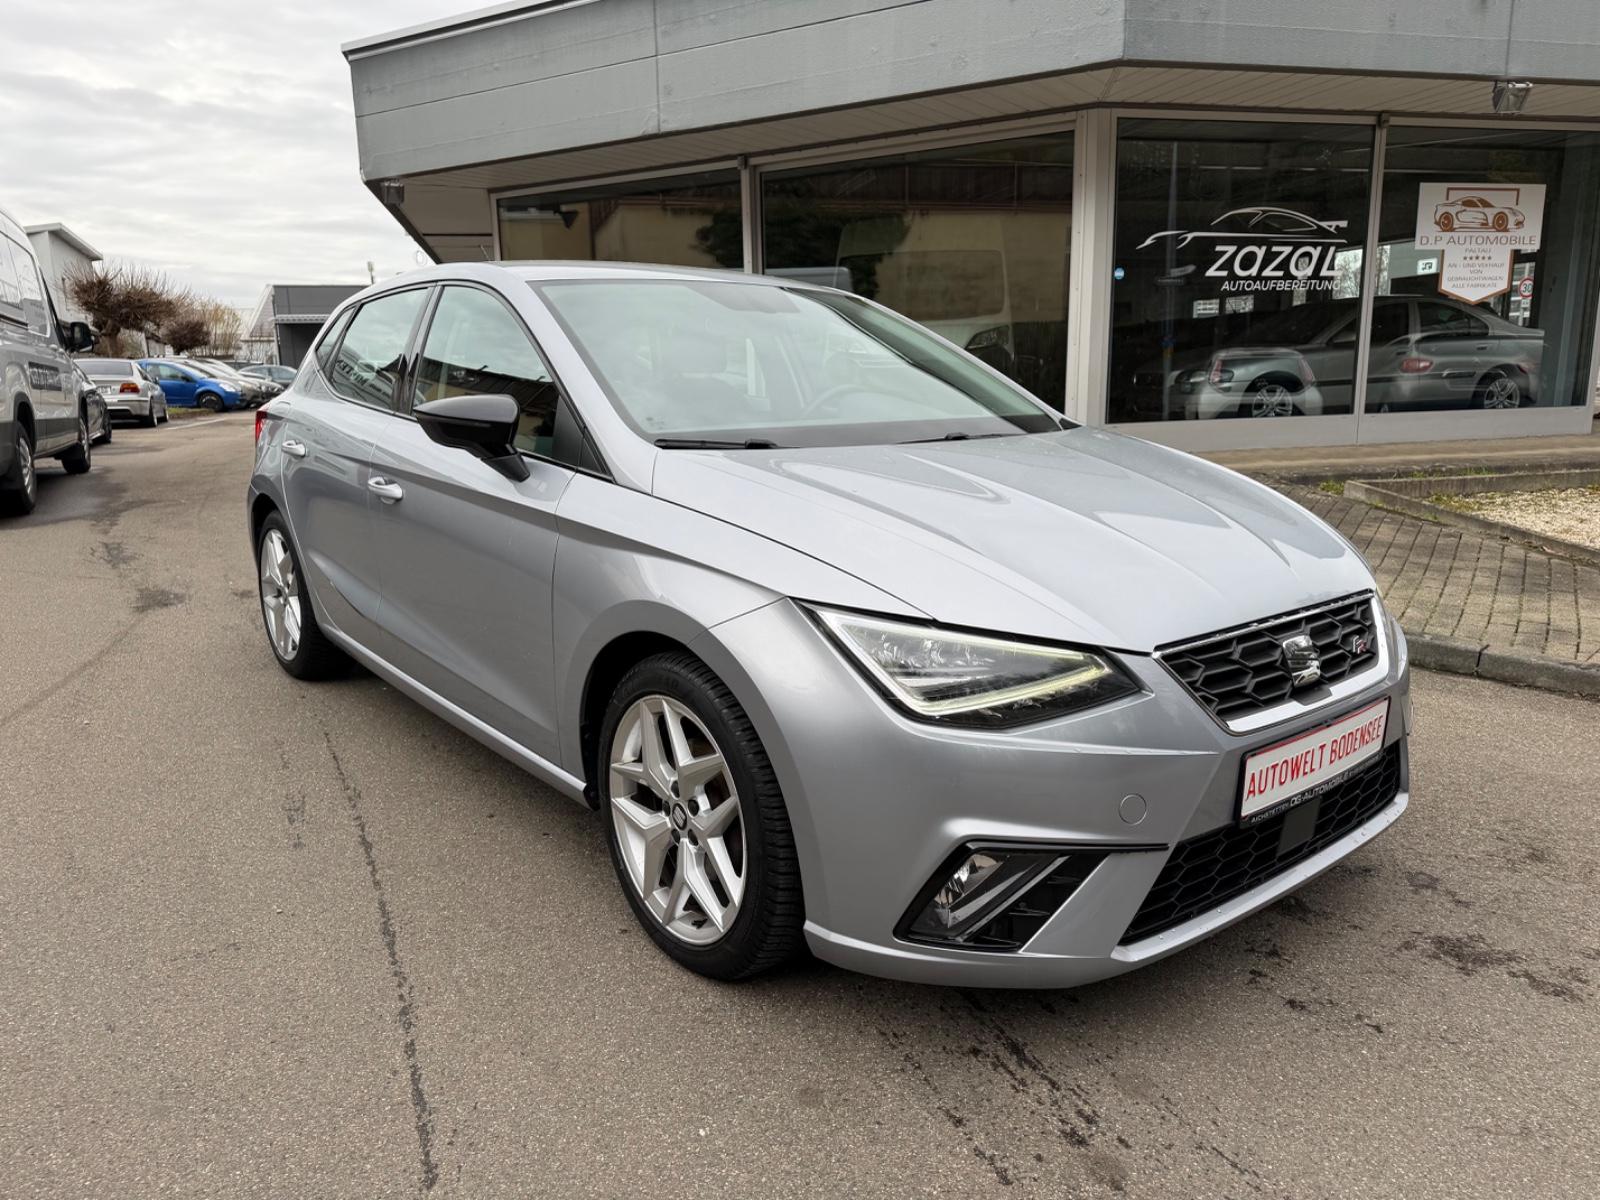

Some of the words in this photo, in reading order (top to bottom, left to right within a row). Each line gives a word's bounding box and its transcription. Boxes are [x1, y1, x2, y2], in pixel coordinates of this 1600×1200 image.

[1446, 235, 1537, 246] AUTOMOBILE
[1220, 280, 1342, 292] AUTOAUFBEREITUNG
[1522, 283, 1533, 294] 30
[1245, 743, 1327, 802] AUTOWELT
[1329, 714, 1384, 766] BODENSEE
